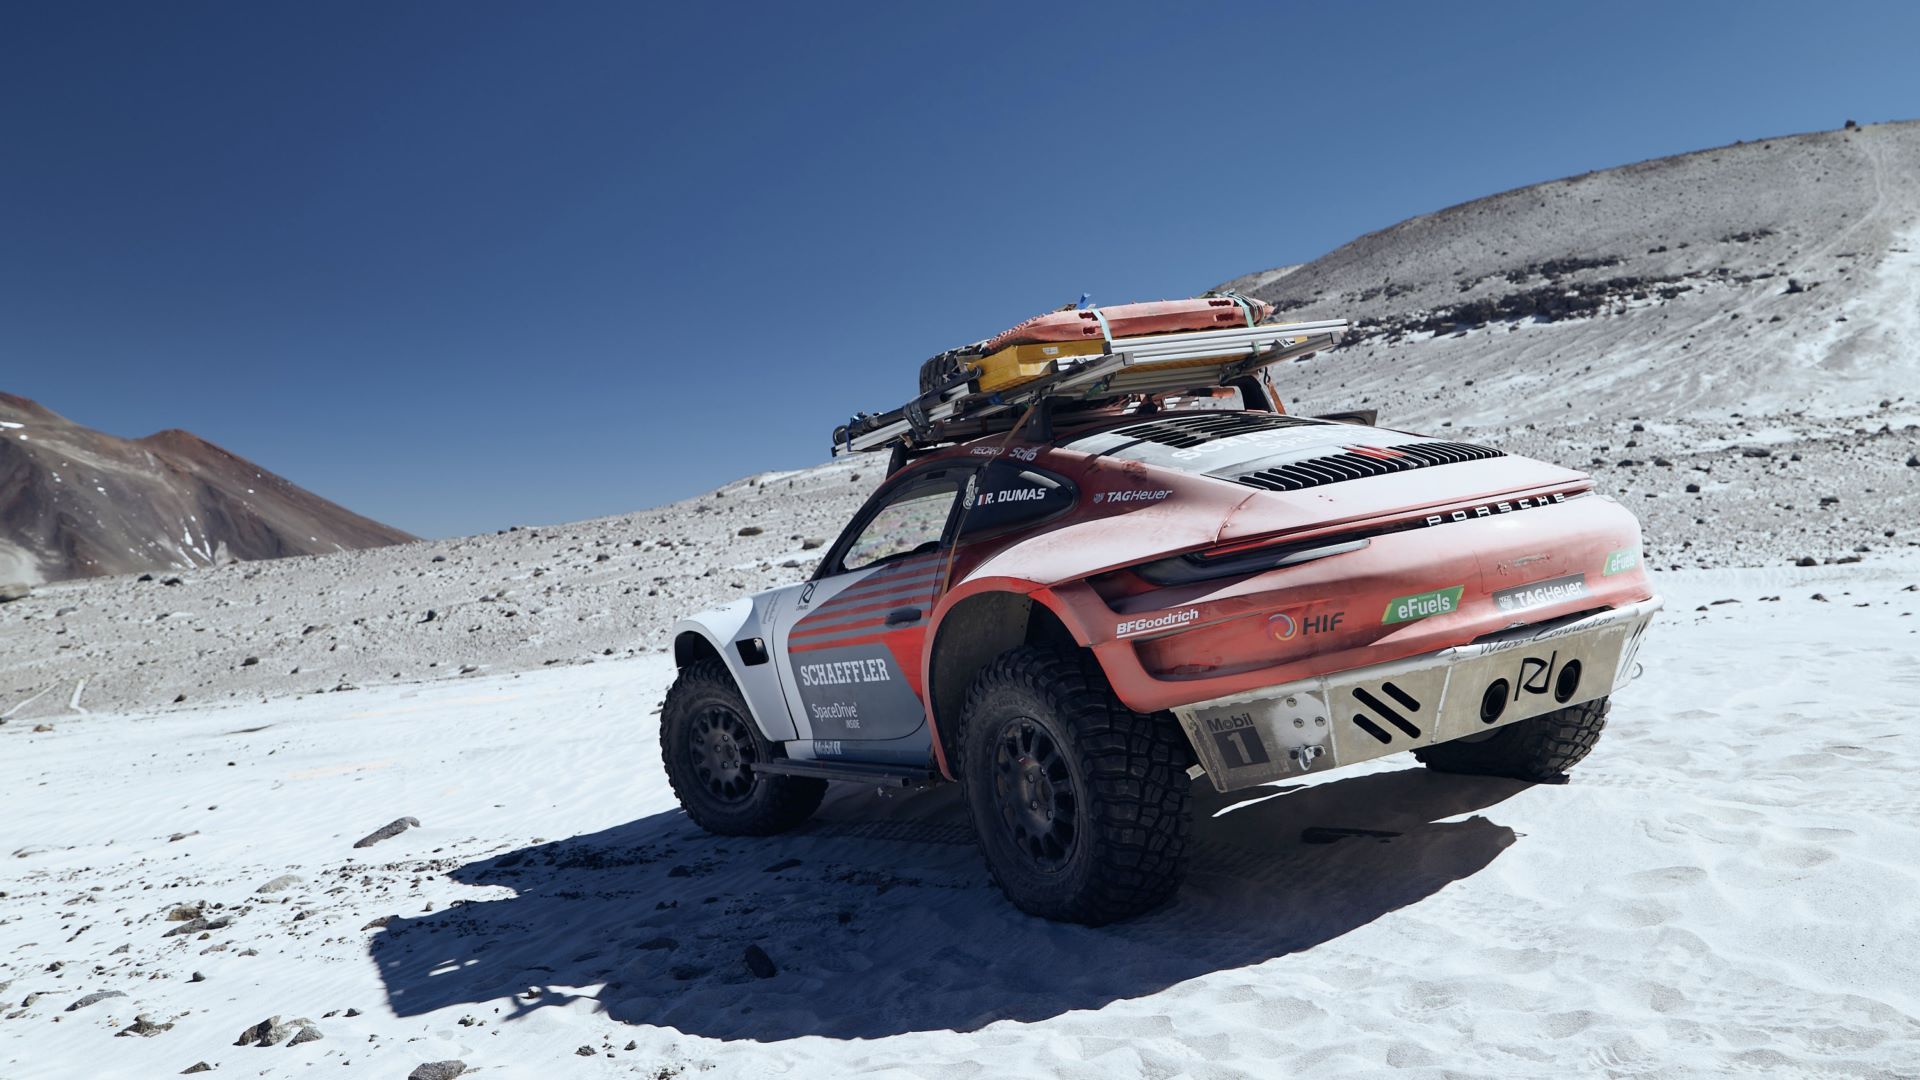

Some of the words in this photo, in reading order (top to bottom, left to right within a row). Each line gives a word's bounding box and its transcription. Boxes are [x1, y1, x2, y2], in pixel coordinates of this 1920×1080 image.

[984, 492, 995, 505] R.
[998, 487, 1047, 503] DUMAS
[1426, 492, 1566, 527] PORSCHE
[1398, 593, 1450, 619] eFuels
[1116, 608, 1199, 635] BFGoodrich
[1303, 612, 1345, 636] HIF
[800, 658, 891, 686] SCHAEFFLER
[811, 702, 858, 722] SpaceDrive
[1206, 712, 1254, 732] Mobil
[1226, 731, 1253, 764] 1
